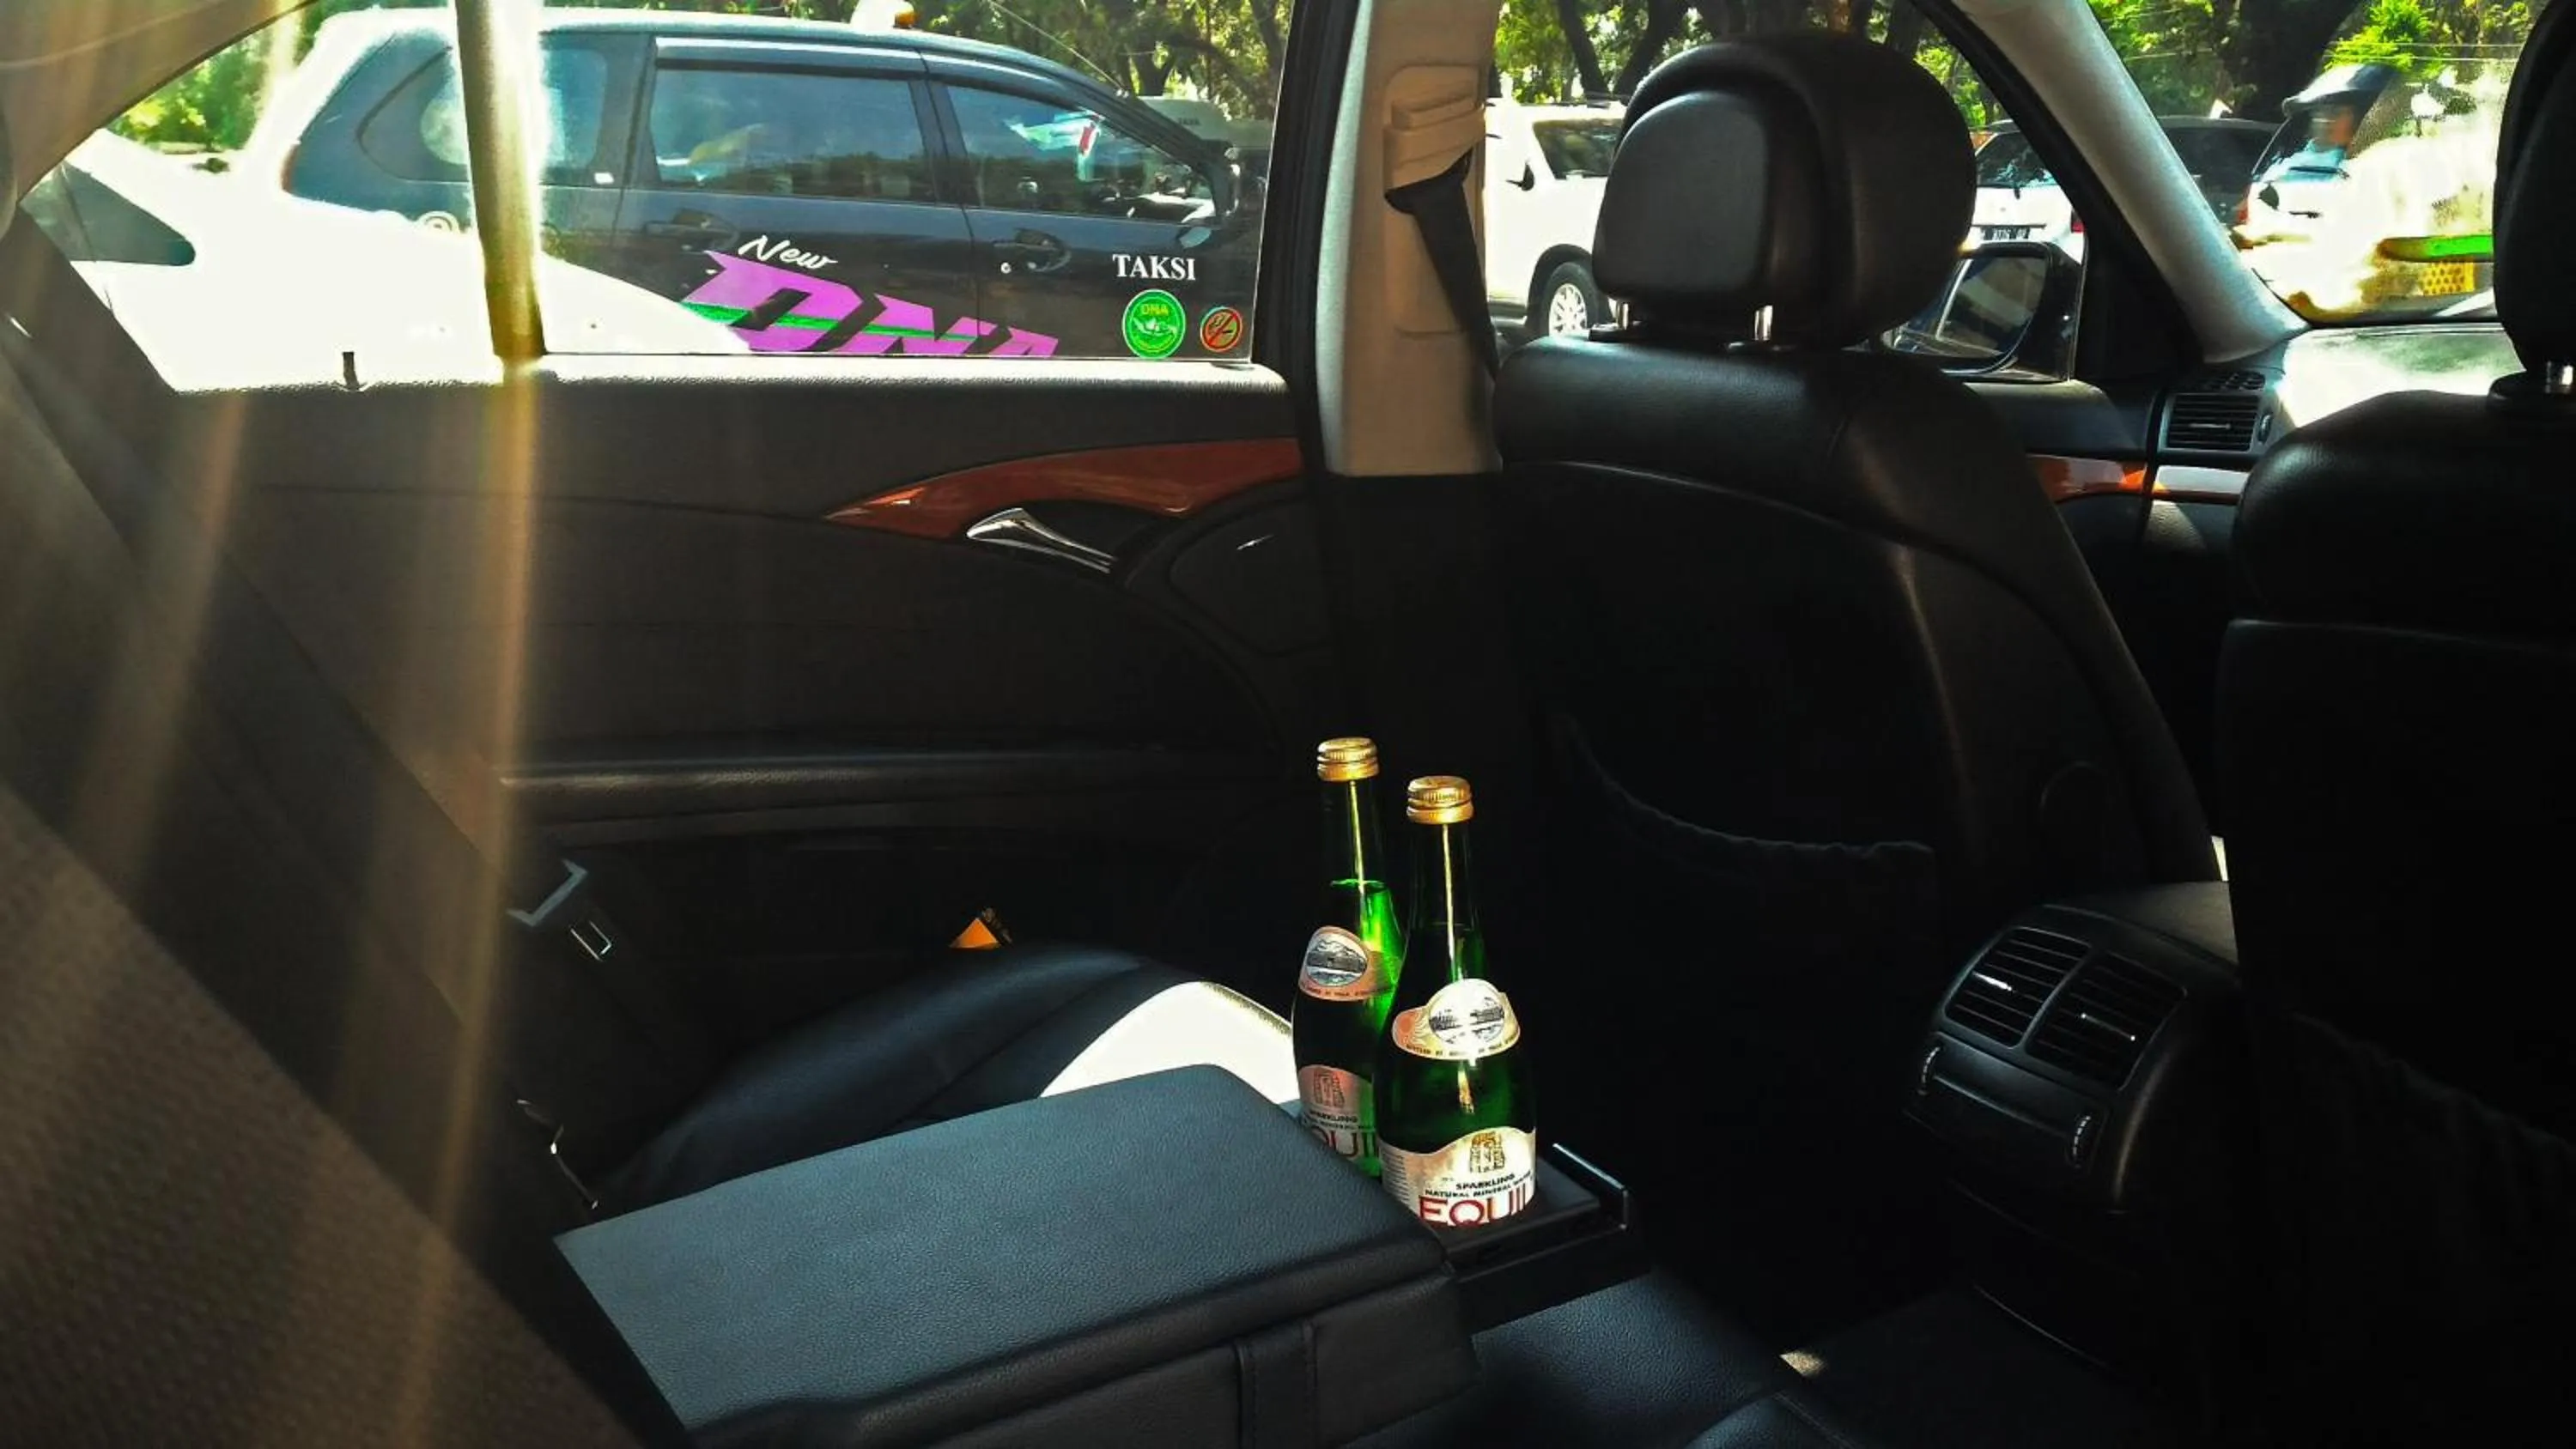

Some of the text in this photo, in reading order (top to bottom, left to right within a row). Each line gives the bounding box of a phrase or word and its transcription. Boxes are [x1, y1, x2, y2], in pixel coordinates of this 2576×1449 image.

[738, 233, 839, 270] New
[1113, 253, 1196, 281] TAKSI
[1455, 1173, 1516, 1191] SPARKLING
